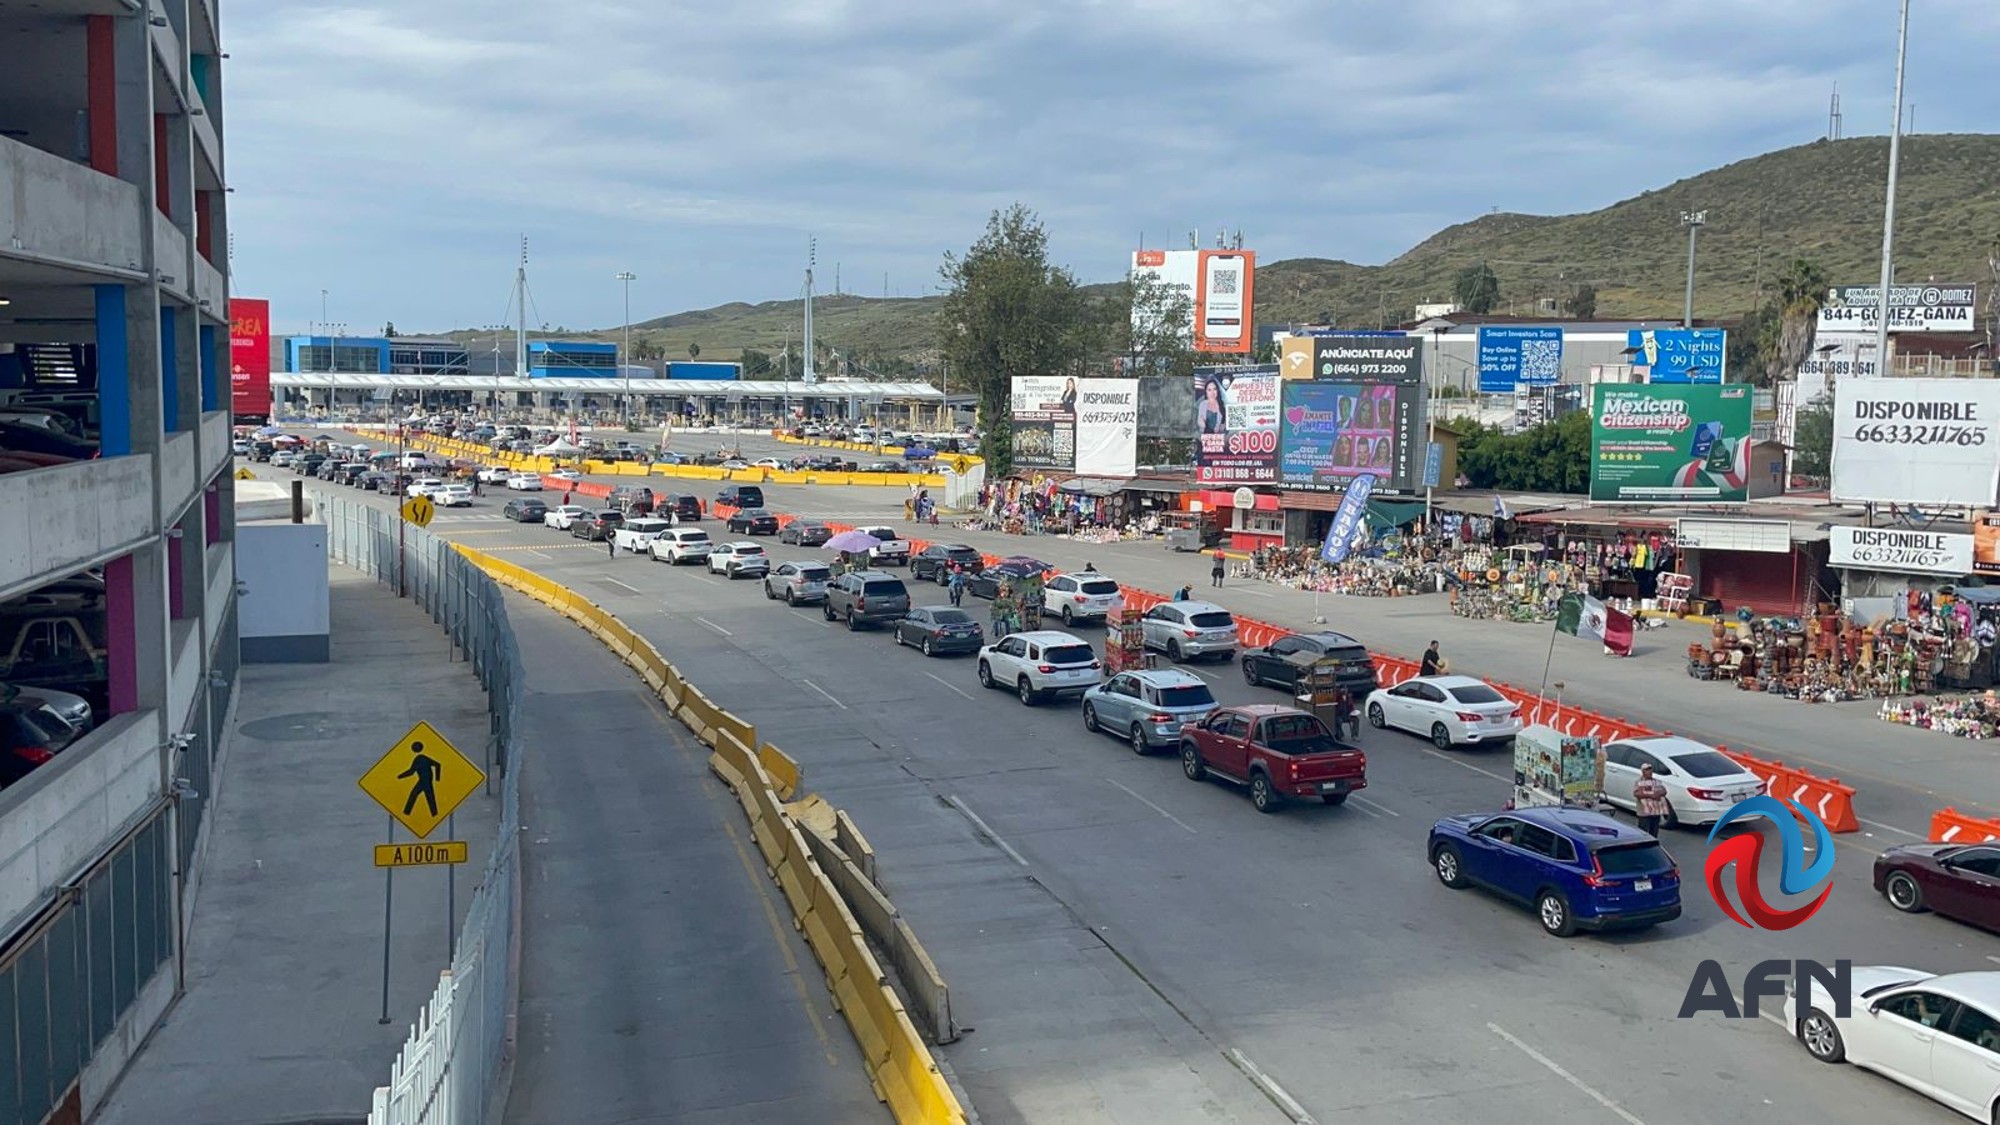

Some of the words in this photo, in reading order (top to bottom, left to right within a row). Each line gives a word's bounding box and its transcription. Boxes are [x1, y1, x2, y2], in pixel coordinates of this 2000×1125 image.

[1385, 346, 1415, 360] AQUÍ
[1666, 340, 1674, 351] 2
[1678, 340, 1720, 354] Nights
[1334, 364, 1359, 374] (664)
[1361, 364, 1379, 374] 973
[1381, 364, 1406, 374] 2200
[1670, 355, 1686, 367] 99
[1690, 355, 1719, 367] USD
[1083, 392, 1132, 405] DISPONIBLE
[1604, 396, 1684, 413] Mexican
[1856, 400, 1977, 421] DISPONIBLE
[1600, 412, 1687, 429] Citizenship
[1229, 430, 1276, 454] $100
[1399, 402, 1408, 477] DISPONIBLE
[1855, 424, 1988, 446] 6633211765
[1214, 468, 1234, 479] (310)
[1852, 530, 1948, 550] DISPONIBLE
[1852, 548, 1942, 566] 6633211765
[394, 847, 403, 863] A
